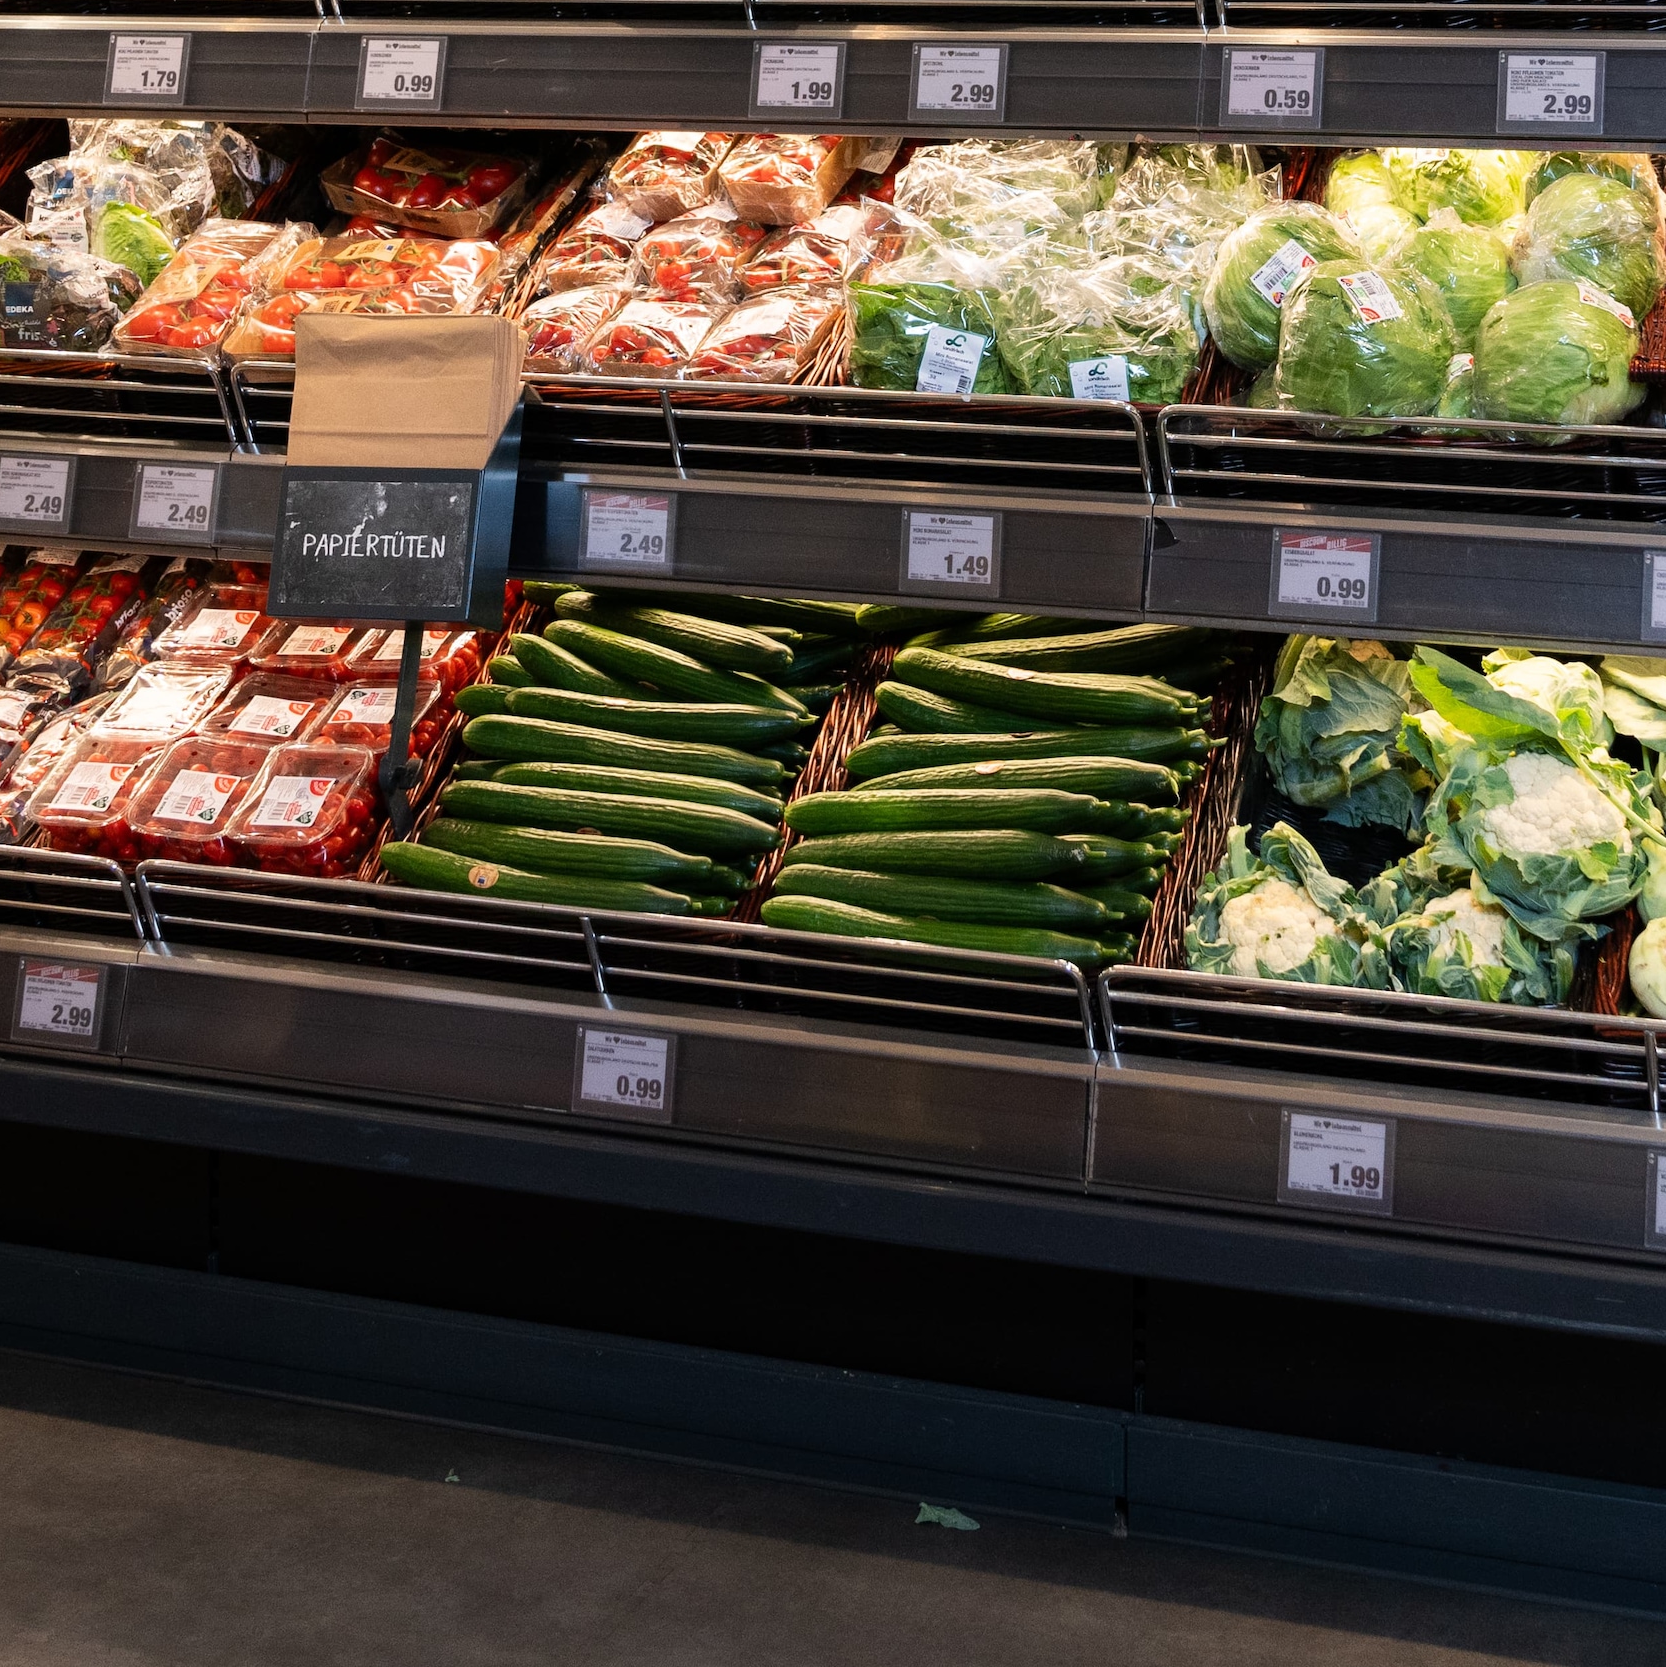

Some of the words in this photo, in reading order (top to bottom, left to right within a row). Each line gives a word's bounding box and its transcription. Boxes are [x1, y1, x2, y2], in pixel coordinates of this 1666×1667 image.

[141, 71, 177, 87] 1.79
[394, 75, 433, 92] 0.99
[791, 82, 832, 100] 1.99
[951, 84, 994, 102] 2.99
[1265, 90, 1310, 108] 0.59
[1544, 95, 1591, 114] 2.99
[6, 306, 35, 314] EDEKA
[24, 495, 62, 514] 2.49
[168, 504, 208, 523] 2.49
[302, 531, 446, 559] PAPIERTÜTEN
[620, 533, 663, 554] 2.49
[1327, 538, 1347, 550] BILLIG
[945, 554, 989, 576] 1.49
[1317, 576, 1366, 599] 0.99
[165, 589, 193, 622] brioso
[51, 1004, 92, 1028] 2.99
[617, 1075, 662, 1100] 0.99
[1329, 1163, 1380, 1190] 1.99
